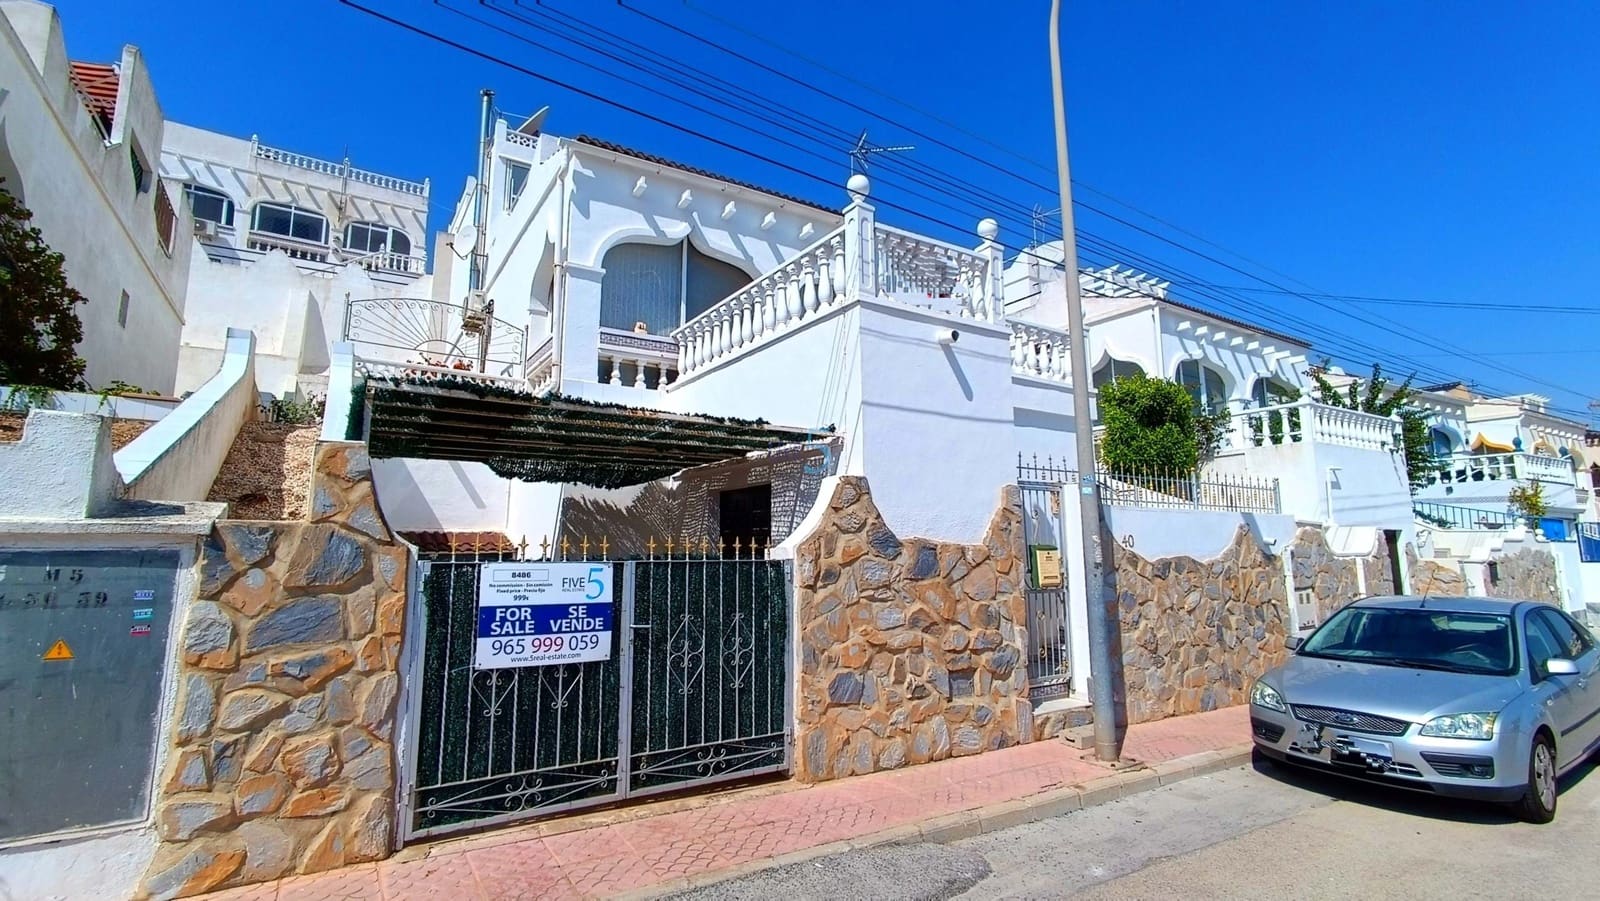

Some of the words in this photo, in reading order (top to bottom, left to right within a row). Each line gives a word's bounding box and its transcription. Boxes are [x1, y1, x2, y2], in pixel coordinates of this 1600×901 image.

[1121, 534, 1135, 548] 40
[562, 577, 585, 588] FIVE
[585, 567, 604, 600] 5
[495, 607, 532, 621] FOR
[568, 605, 587, 618] SE
[490, 620, 535, 635] SALE
[549, 617, 604, 632] VENDE
[491, 638, 525, 656] 965
[531, 636, 564, 654] 999
[569, 634, 599, 651] 059
[510, 652, 581, 663] www.5real-estate.com
